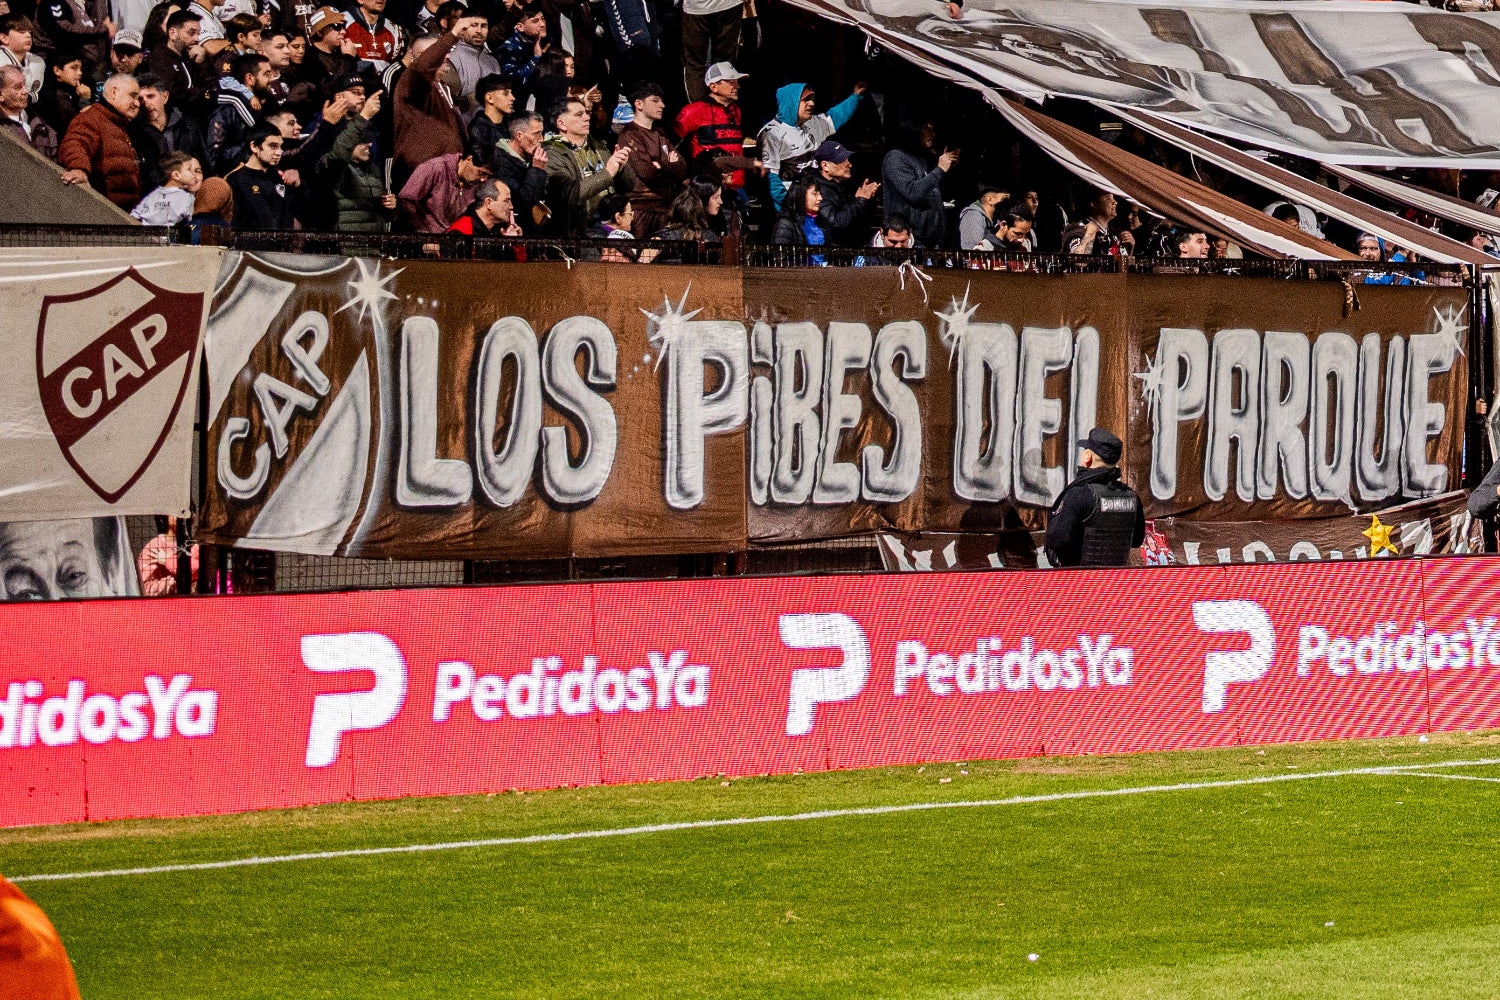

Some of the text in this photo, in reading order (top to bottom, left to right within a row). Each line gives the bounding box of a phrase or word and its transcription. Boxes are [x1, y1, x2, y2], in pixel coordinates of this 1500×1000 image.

[60, 312, 169, 421] CAP
[217, 310, 332, 500] CAP
[397, 316, 619, 509] LOS
[953, 321, 1100, 507] DEL
[1149, 327, 1458, 512] PARQUE
[433, 650, 711, 722] PedidosYa
[893, 634, 1134, 696] PedidosYa
